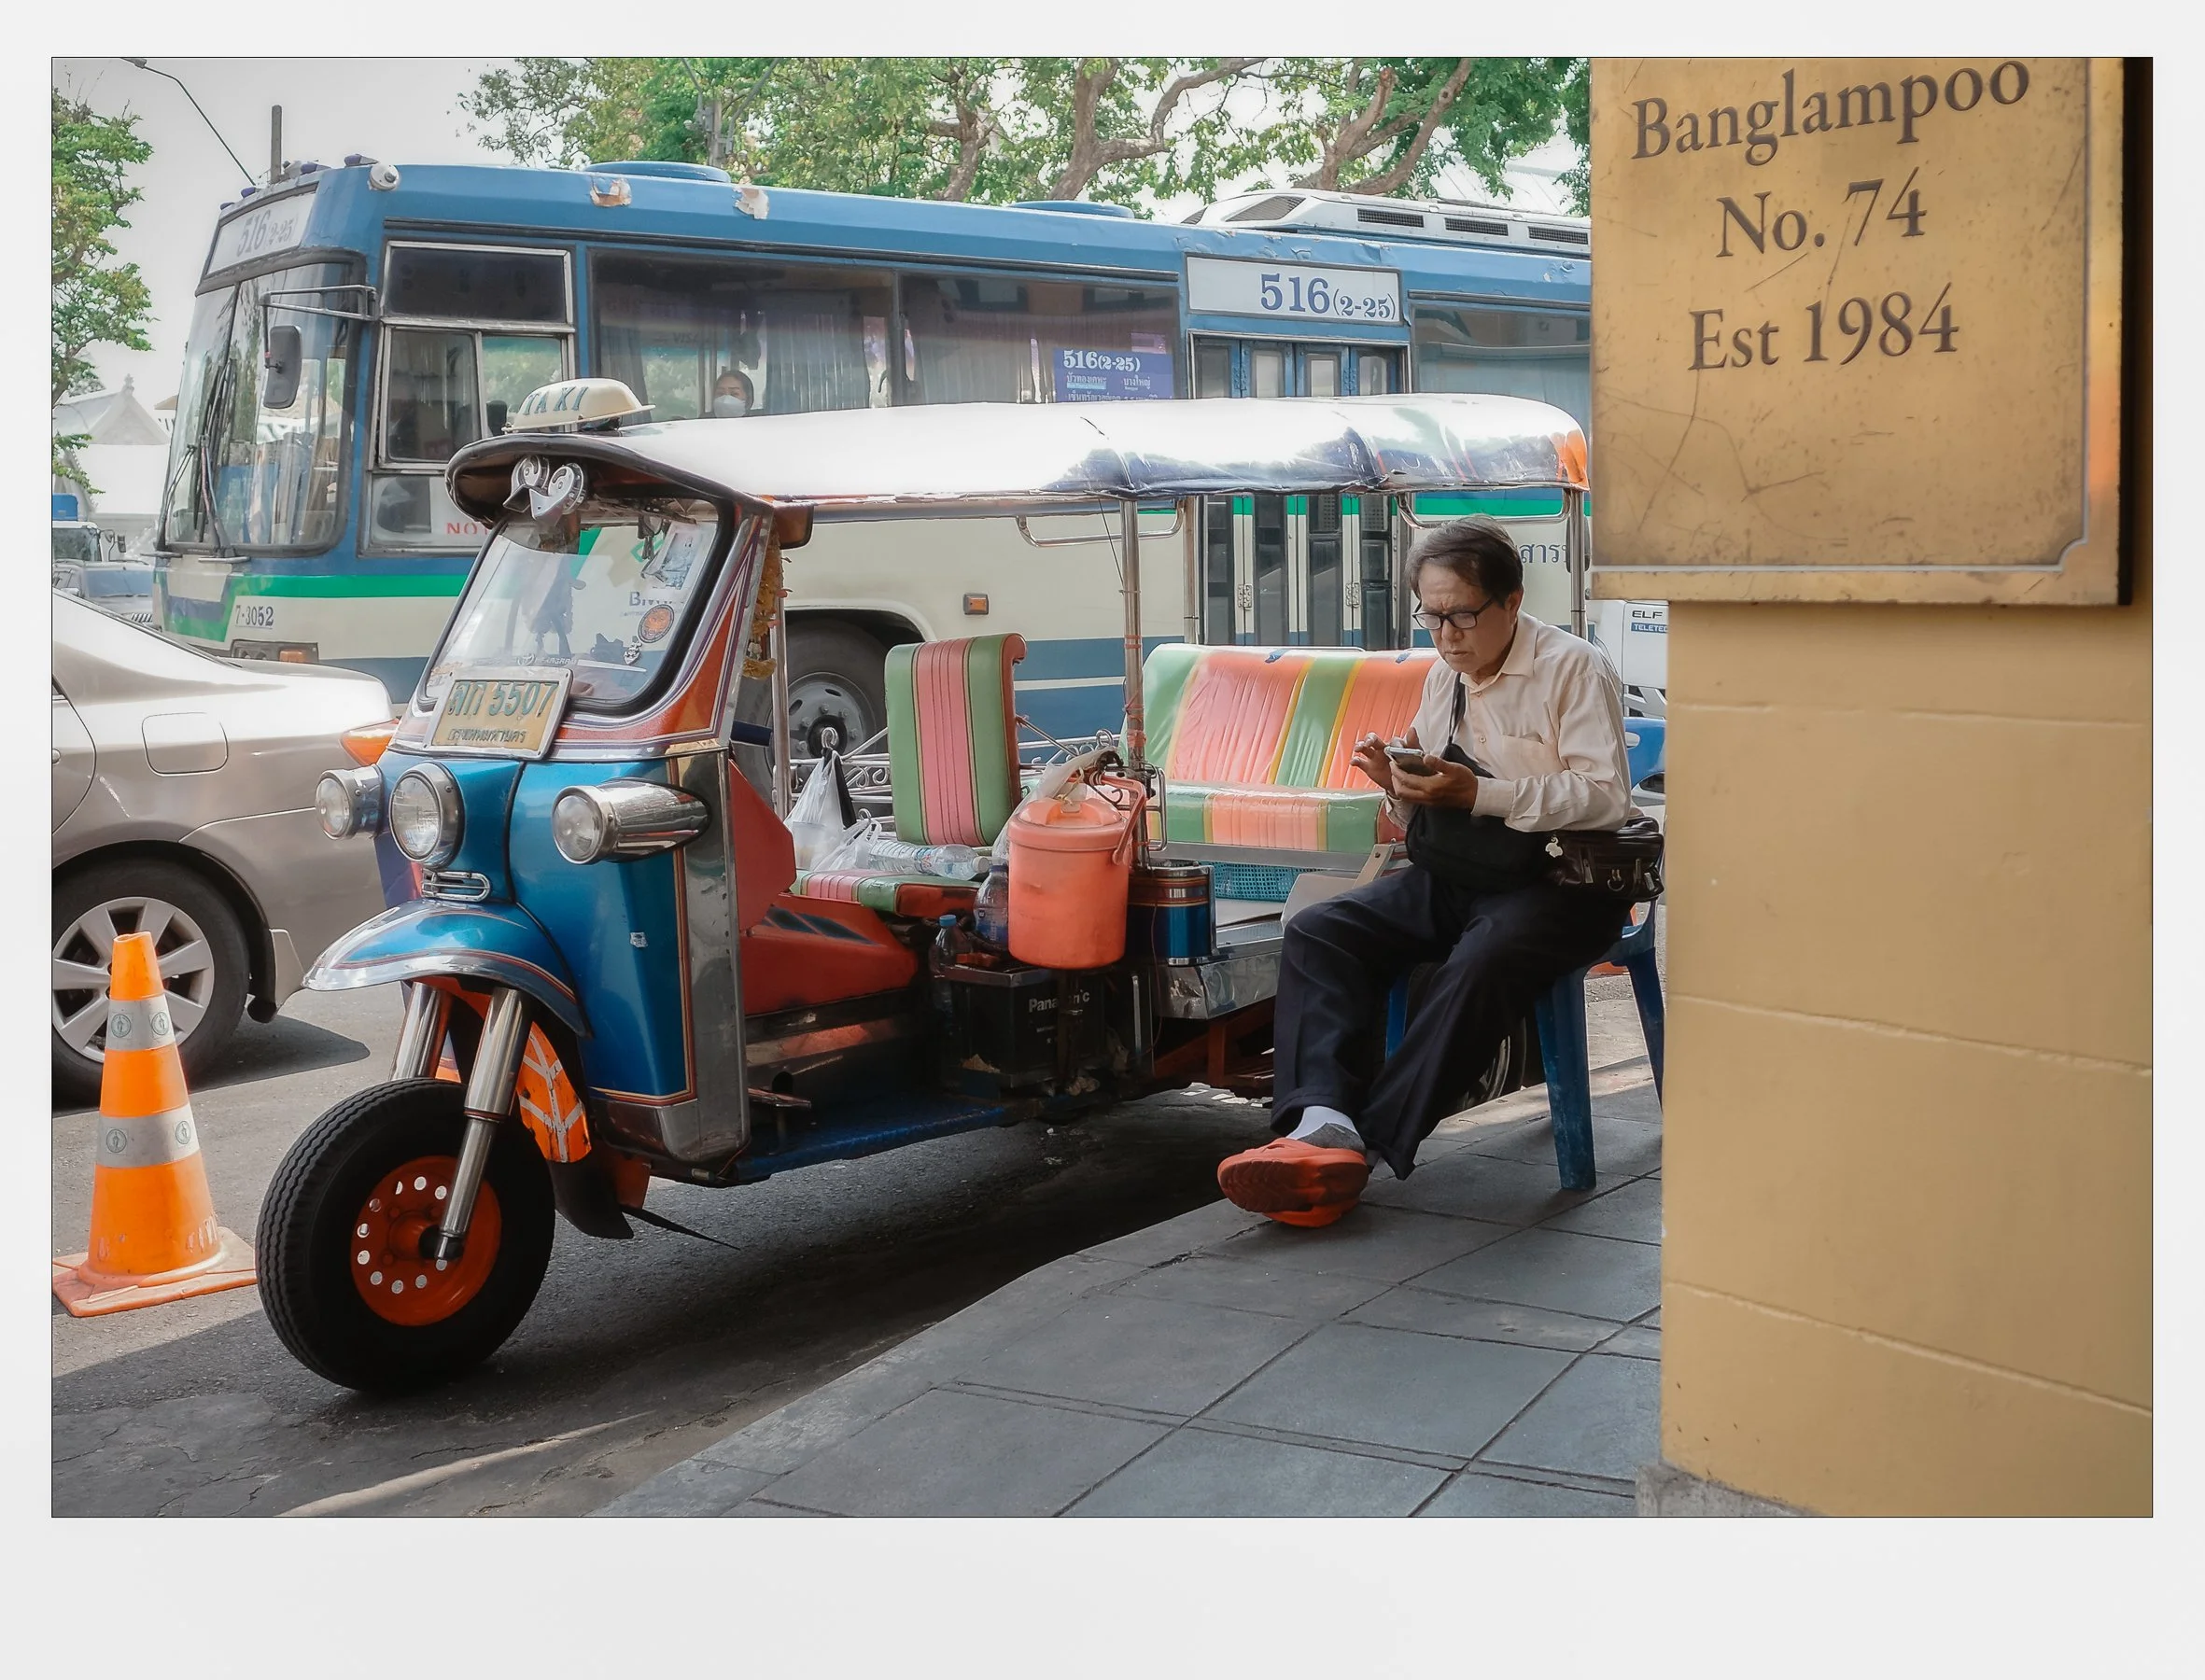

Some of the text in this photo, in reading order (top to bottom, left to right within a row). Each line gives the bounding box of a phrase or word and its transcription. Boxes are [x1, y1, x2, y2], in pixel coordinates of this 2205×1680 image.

[1631, 60, 2029, 166] Banglampoo
[1716, 166, 1927, 258] No. 74
[1260, 273, 1396, 320] 516(2-25)
[1687, 282, 1959, 371] Est 1984
[1063, 349, 1141, 372] 516(2-25)
[523, 385, 589, 415] TAXI
[446, 522, 489, 535] NO
[1632, 609, 1664, 620] ELF
[489, 681, 560, 719] 5507
